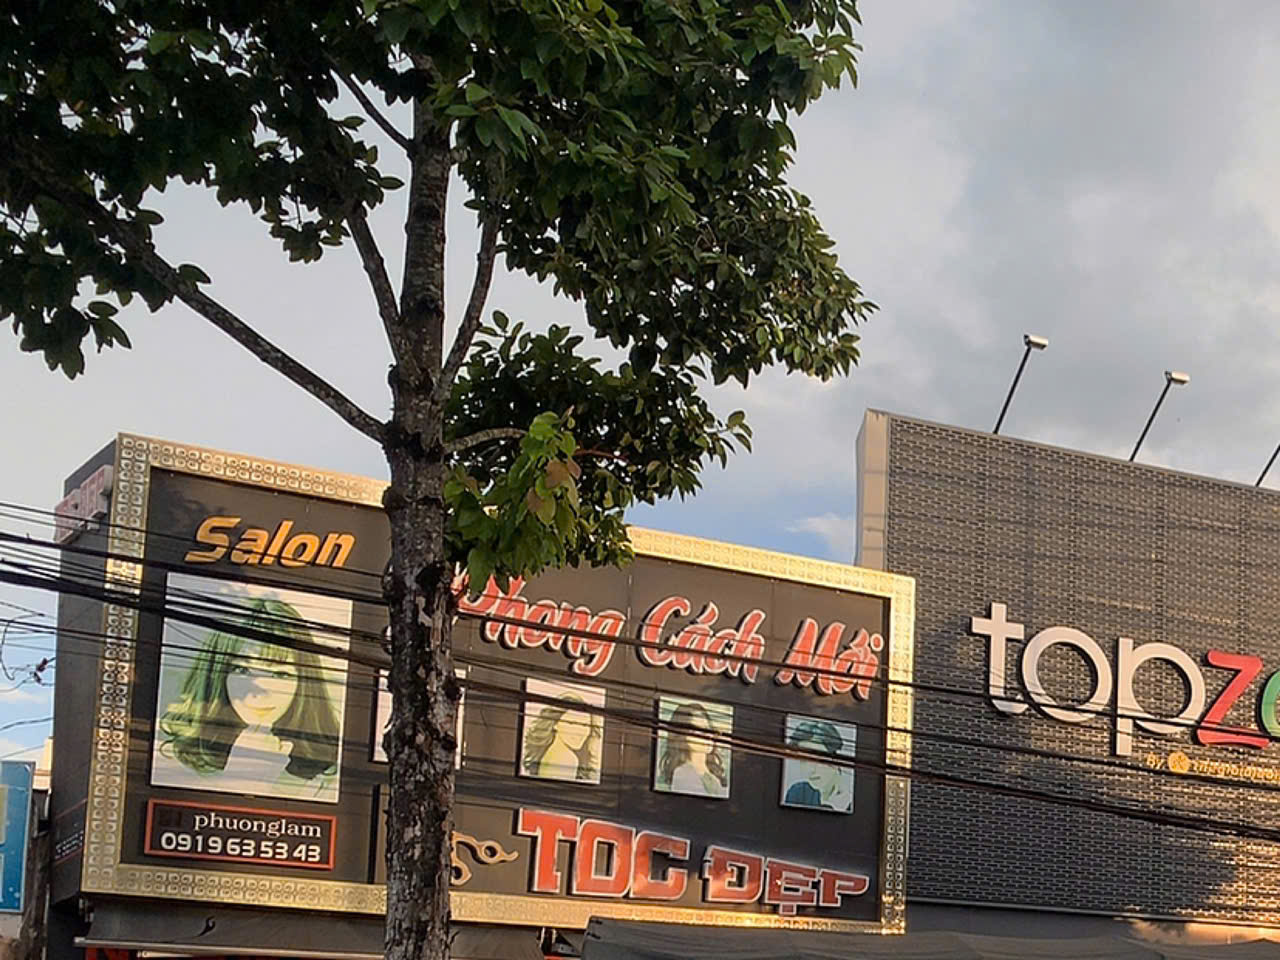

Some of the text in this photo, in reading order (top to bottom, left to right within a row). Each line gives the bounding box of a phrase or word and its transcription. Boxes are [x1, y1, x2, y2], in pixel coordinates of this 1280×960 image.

[184, 516, 357, 568] Salon
[639, 596, 766, 684] Cách
[775, 617, 884, 700] Mới
[194, 812, 322, 838] phuonglam
[517, 807, 870, 915] TOC ĐẸP
